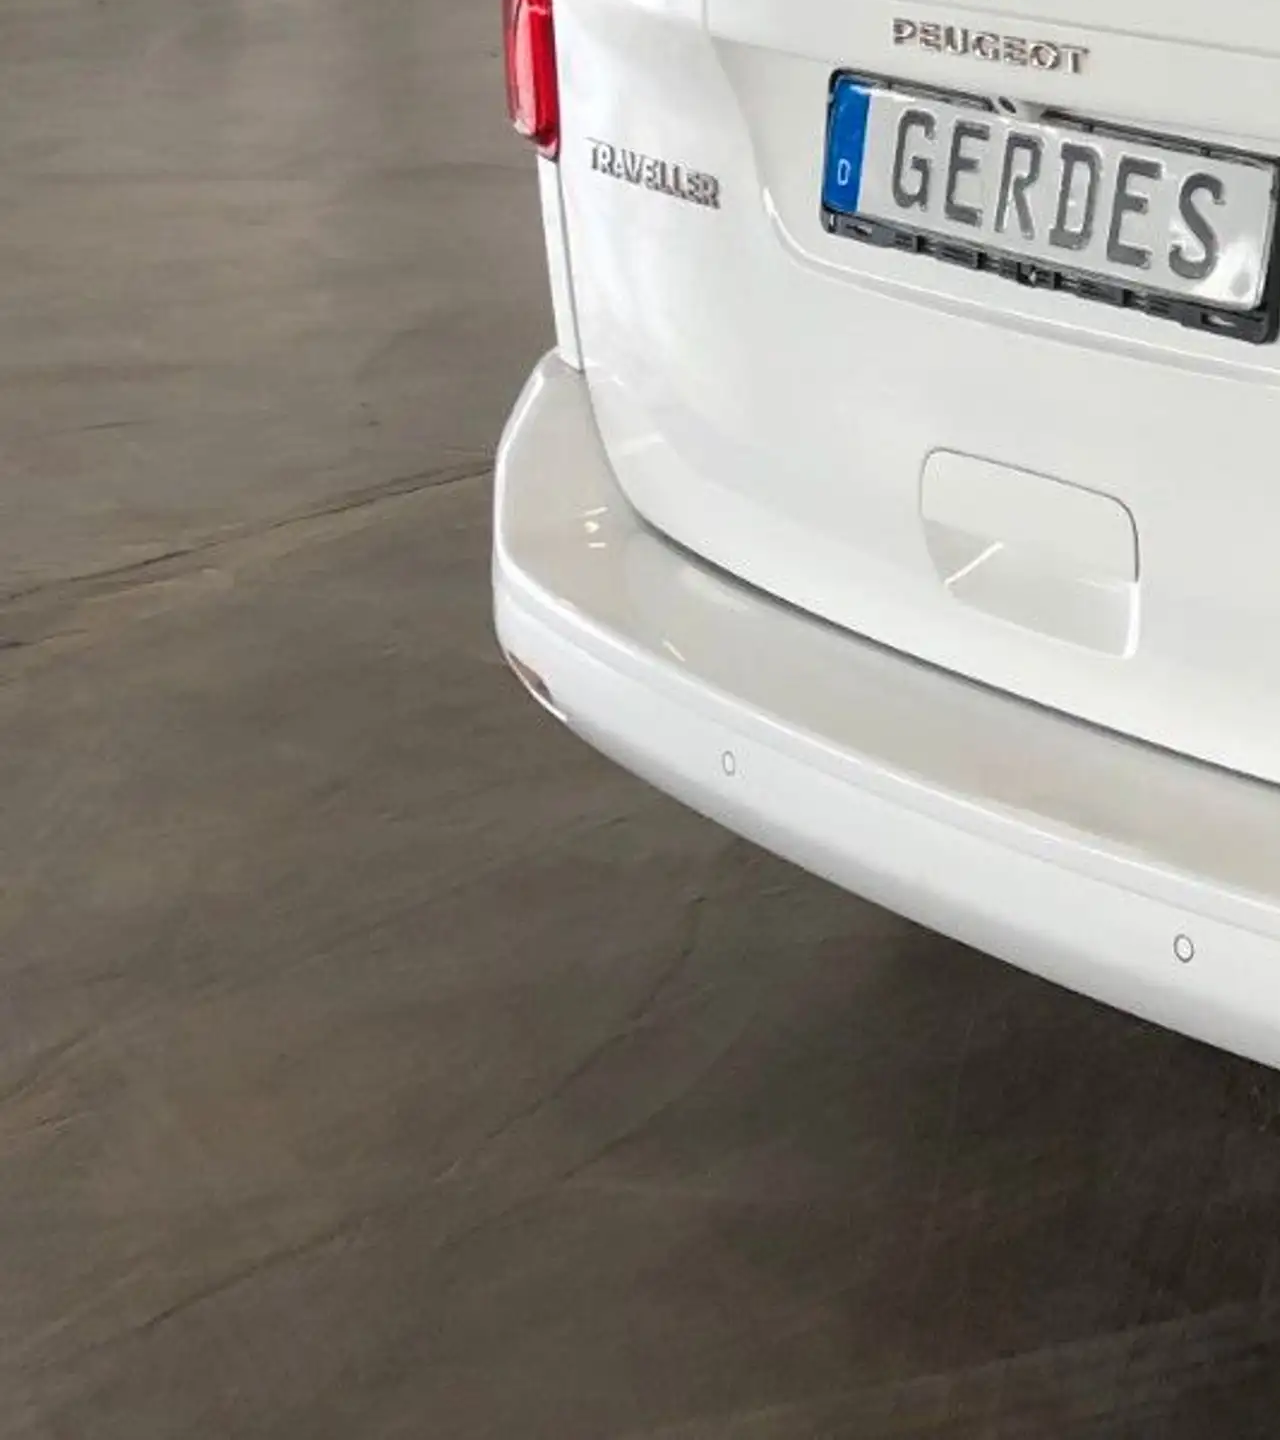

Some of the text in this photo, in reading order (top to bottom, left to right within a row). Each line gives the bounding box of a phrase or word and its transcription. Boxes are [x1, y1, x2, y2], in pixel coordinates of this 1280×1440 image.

[893, 17, 1090, 74] PEUGEOT
[586, 137, 720, 207] TRAVELLER
[836, 157, 851, 186] D
[891, 108, 1225, 280] GERDES
